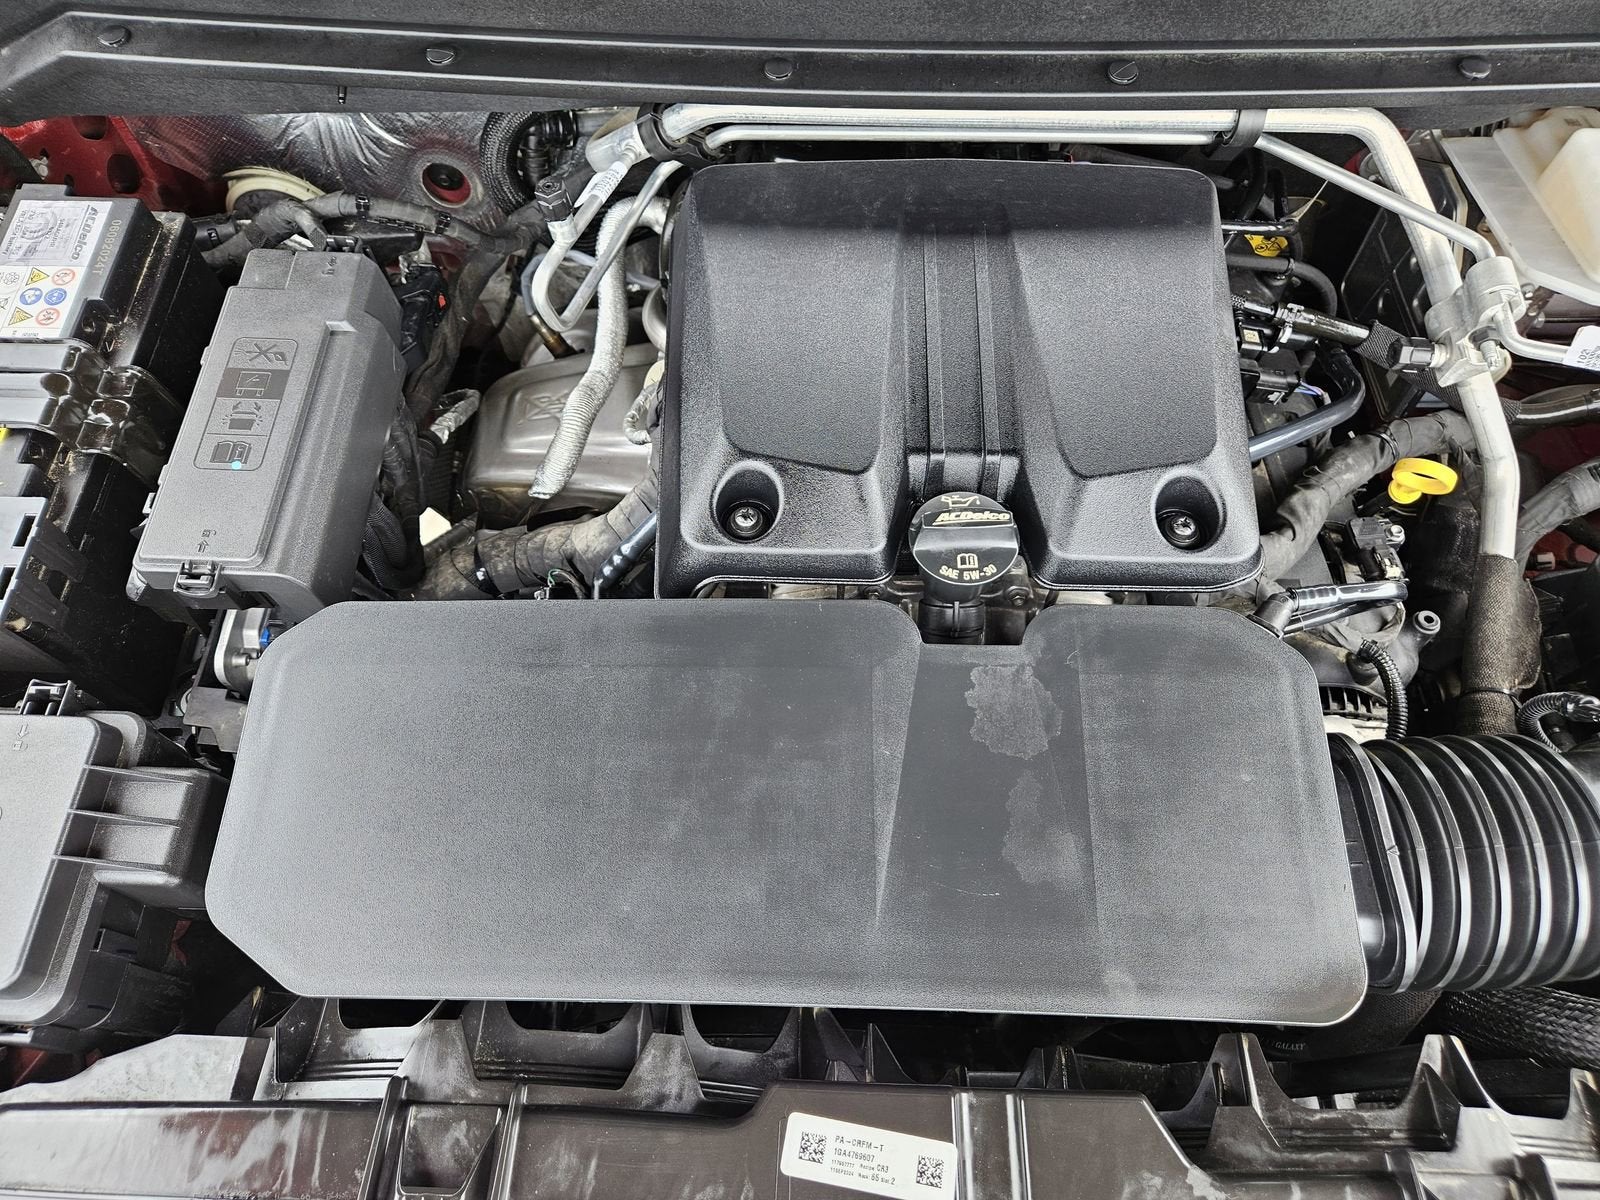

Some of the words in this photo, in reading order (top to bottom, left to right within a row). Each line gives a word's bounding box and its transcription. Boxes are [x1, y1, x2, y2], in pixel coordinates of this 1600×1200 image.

[71, 206, 98, 261] ACDelco
[92, 219, 122, 274] 06092024T
[933, 511, 1010, 524] ACDelco
[939, 564, 960, 580] SAE
[963, 563, 997, 581] 5W-30
